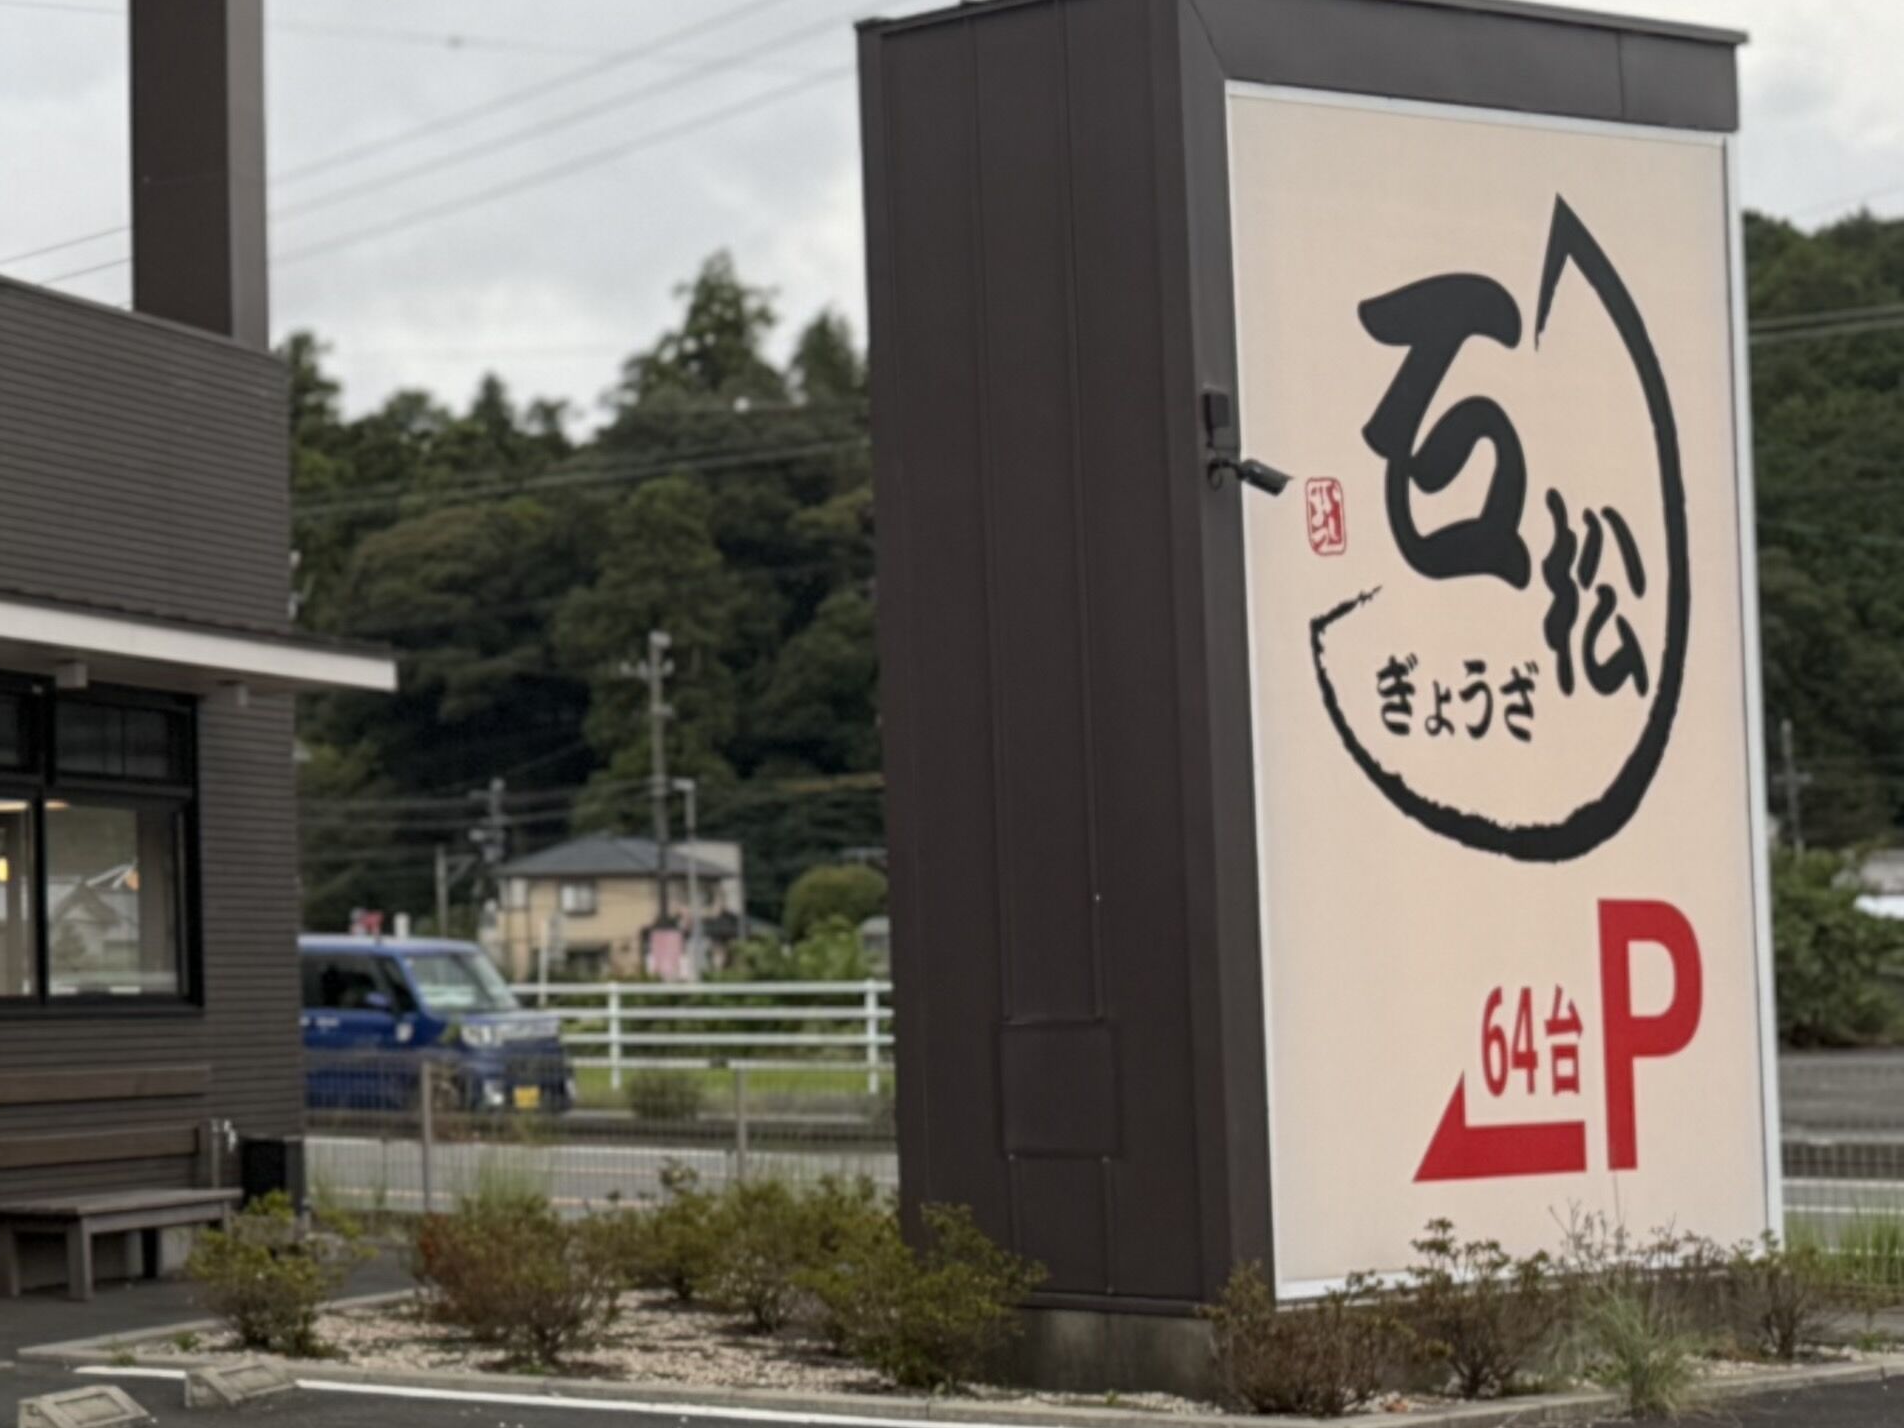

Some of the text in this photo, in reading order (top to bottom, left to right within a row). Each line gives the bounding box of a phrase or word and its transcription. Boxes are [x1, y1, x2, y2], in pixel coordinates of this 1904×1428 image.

[1359, 274, 1649, 696] 石松
[1378, 656, 1536, 741] ぎょうざ
[1480, 984, 1584, 1097] 64台
[1597, 898, 1704, 1171] P
